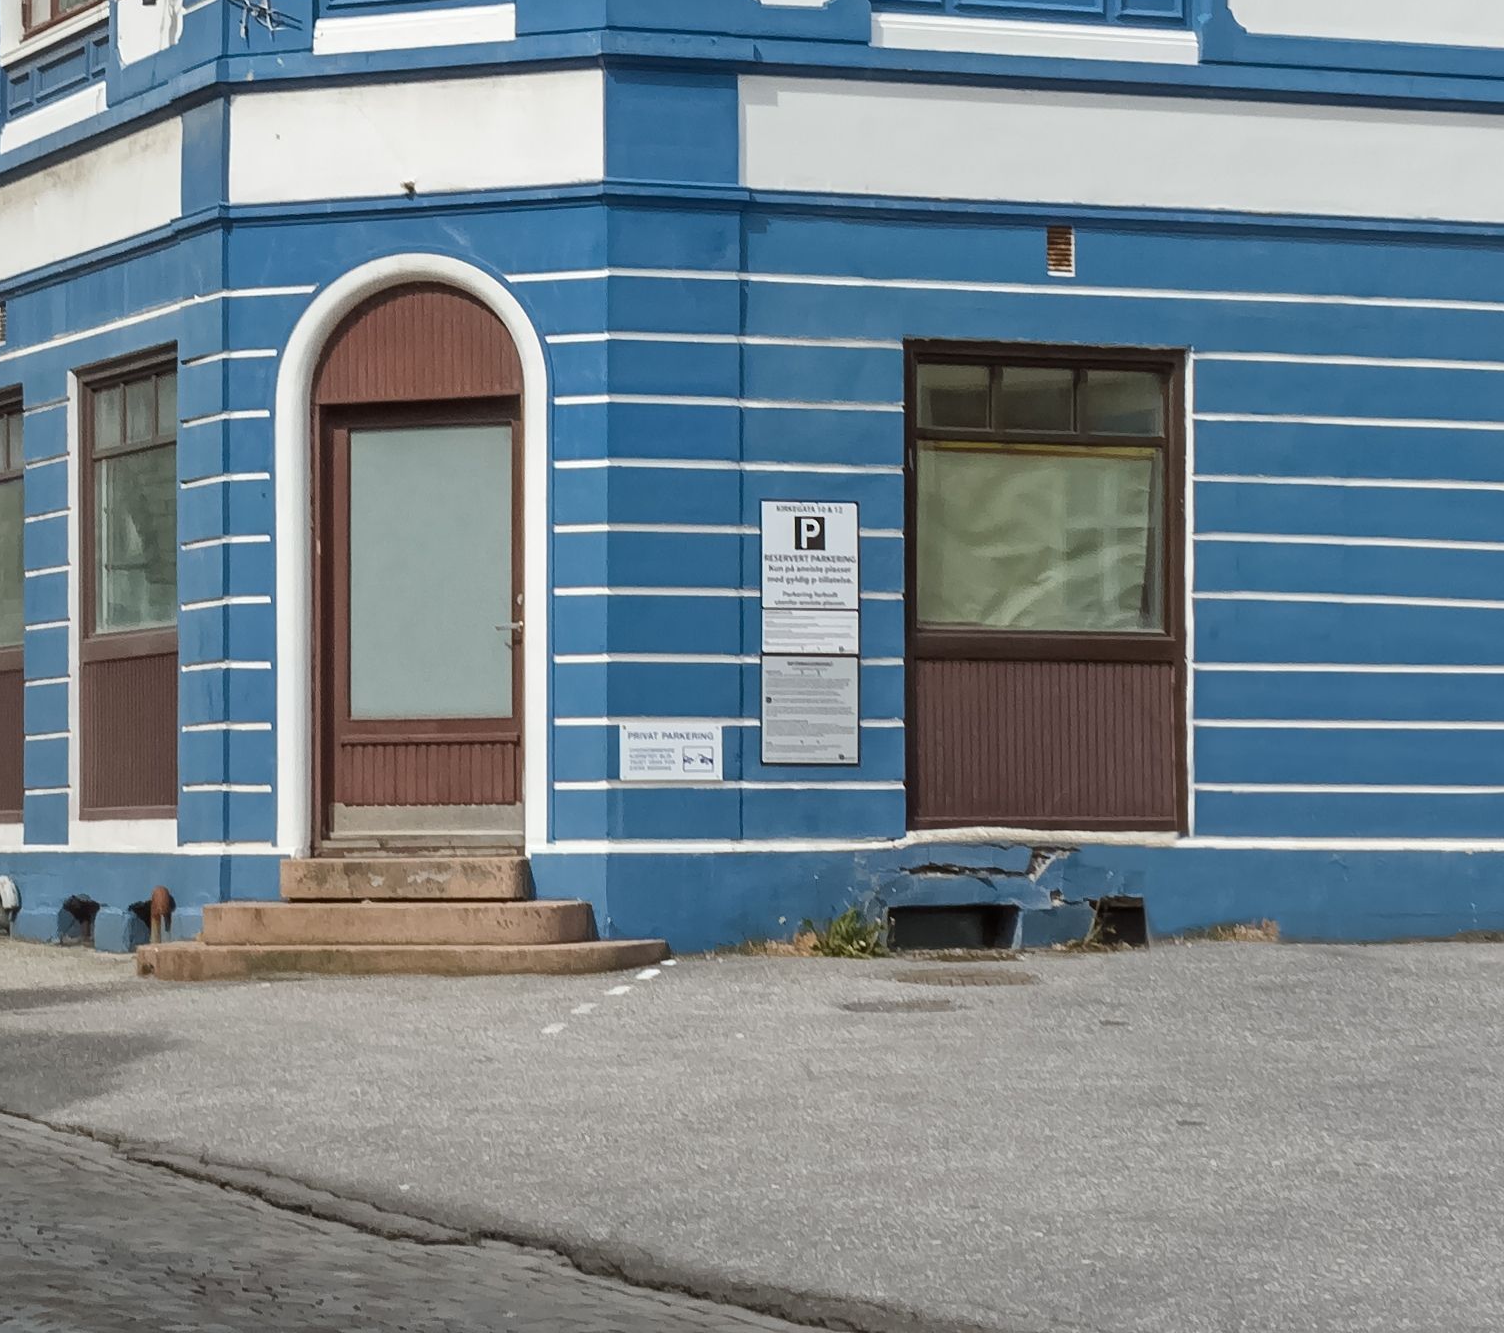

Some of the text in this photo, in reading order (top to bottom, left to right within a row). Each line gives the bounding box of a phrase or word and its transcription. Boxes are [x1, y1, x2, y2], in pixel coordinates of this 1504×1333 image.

[800, 518, 821, 549] P
[764, 554, 856, 563] RESERVERT PARKERING
[627, 732, 714, 741] PRIVAT PARKERING
